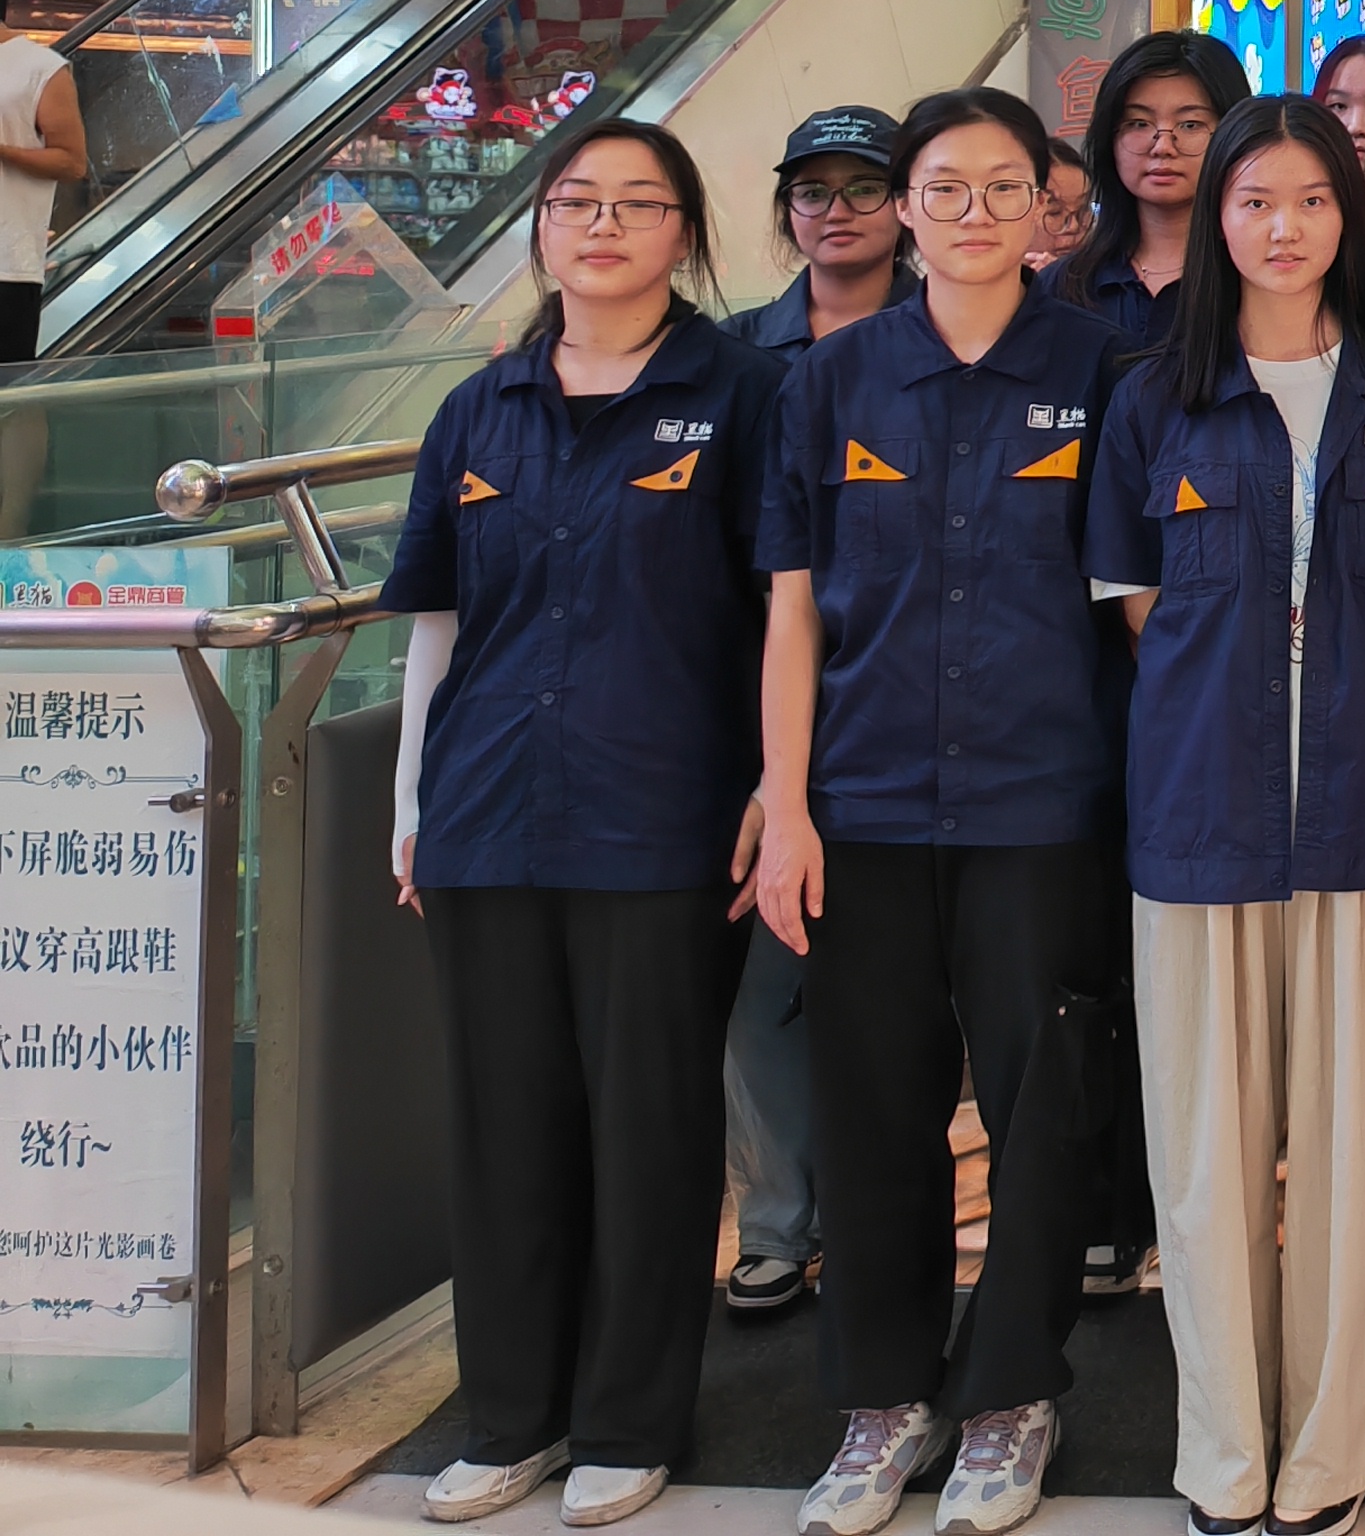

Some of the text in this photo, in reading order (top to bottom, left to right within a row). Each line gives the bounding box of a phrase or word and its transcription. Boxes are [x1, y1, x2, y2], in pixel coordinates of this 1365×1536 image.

[10, 583, 185, 607] 黑猫 金鼎商管
[6, 690, 146, 740] 温馨提示
[0, 925, 176, 975] 议穿高跟鞋
